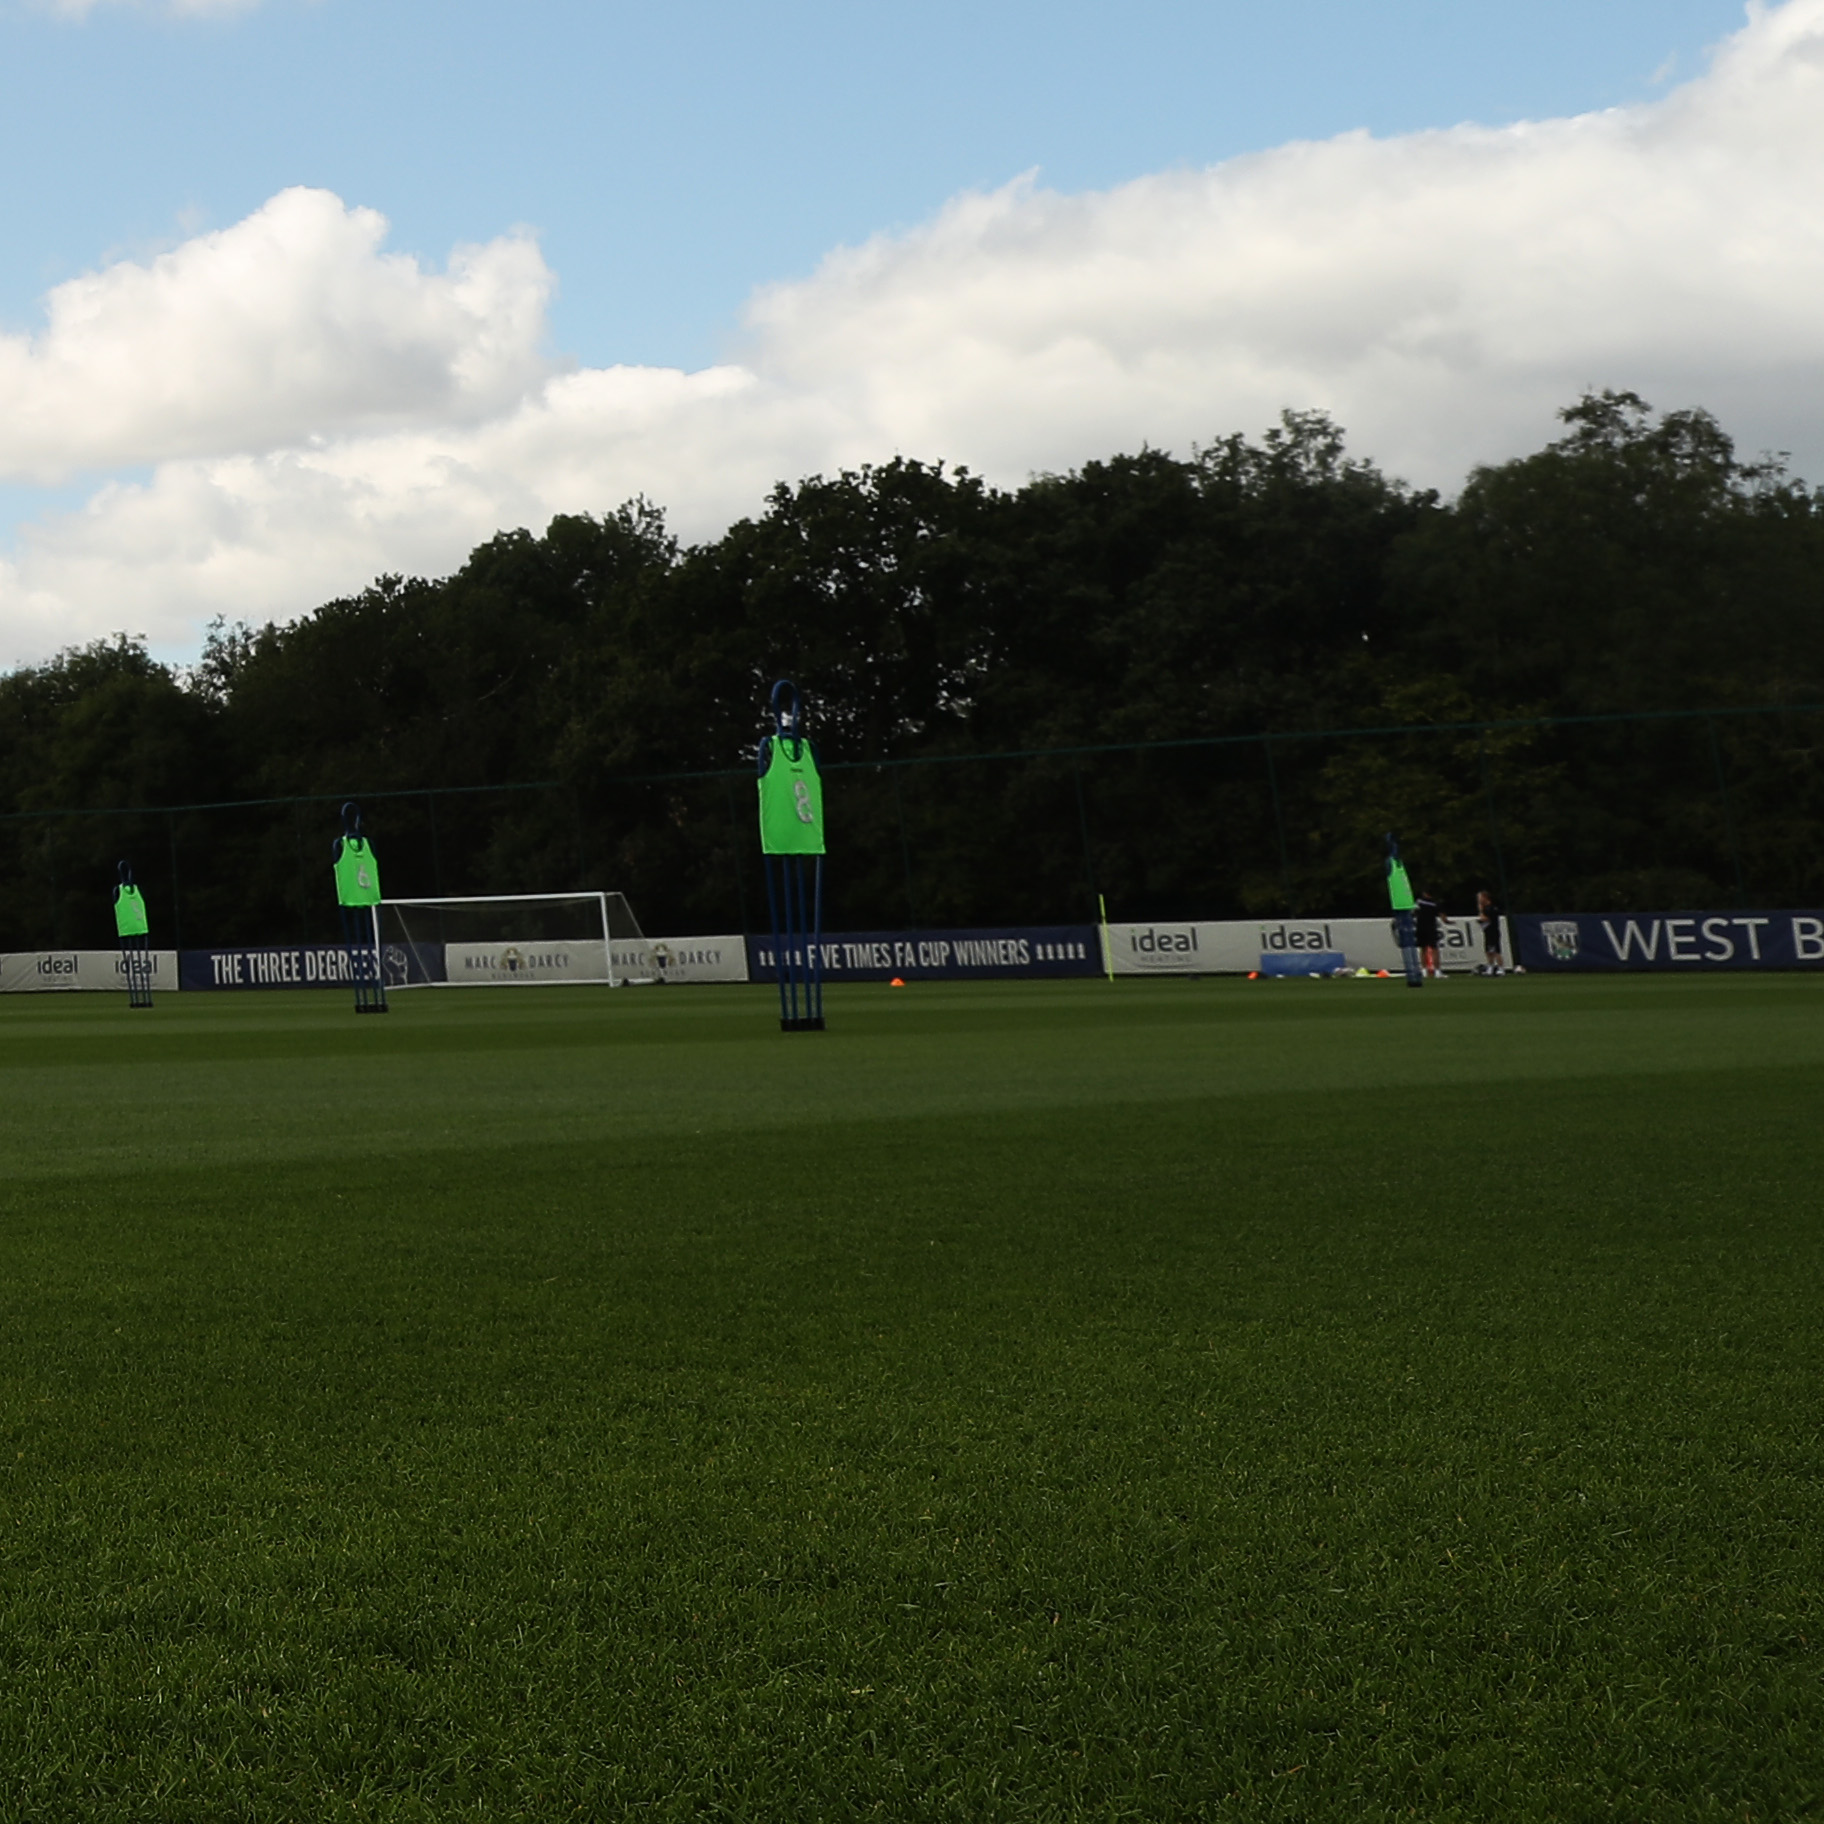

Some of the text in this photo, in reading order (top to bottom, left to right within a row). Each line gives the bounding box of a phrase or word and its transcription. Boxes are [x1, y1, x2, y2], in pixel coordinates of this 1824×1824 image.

[1131, 925, 1198, 952] ideal
[1261, 925, 1333, 950] ideal
[1602, 917, 1769, 961] WEST
[38, 955, 78, 975] ideal
[464, 954, 569, 969] MARC DARCY
[679, 950, 721, 965] DARCY
[807, 939, 1030, 969] FVE TIMES FA CUP WINNERS
[211, 954, 244, 985] THE
[247, 951, 301, 983] THREE
